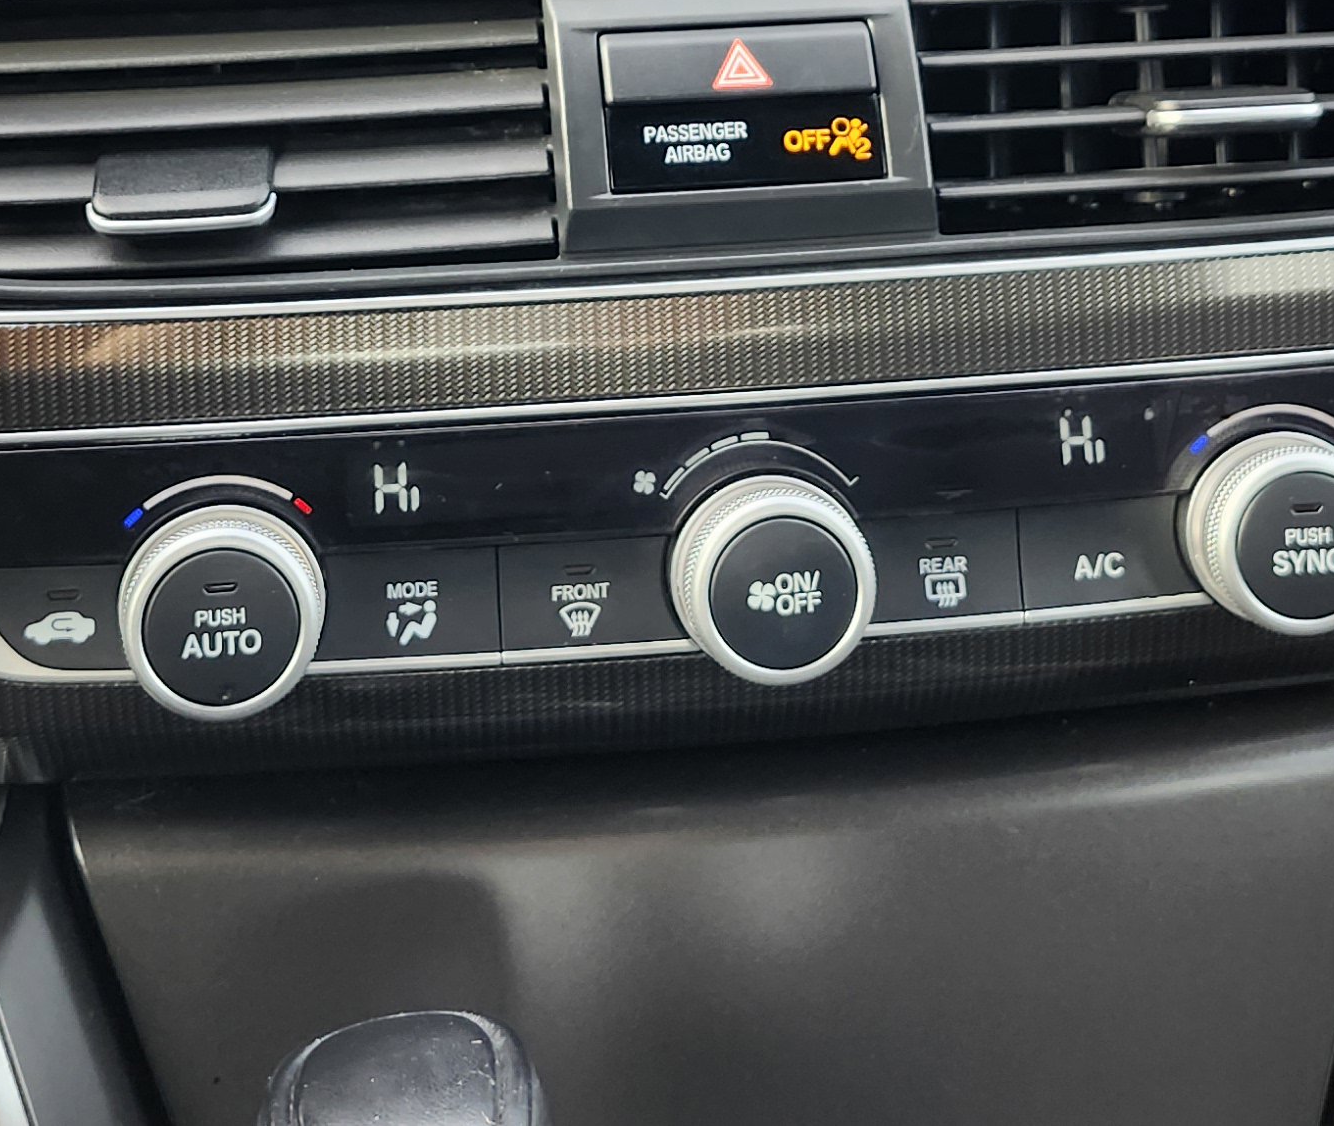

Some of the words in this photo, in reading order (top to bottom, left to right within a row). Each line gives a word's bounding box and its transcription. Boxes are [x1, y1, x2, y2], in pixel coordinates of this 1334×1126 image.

[643, 121, 748, 144] PASSENGER
[783, 128, 831, 154] OFF
[664, 143, 731, 164] AIRBAG
[1284, 526, 1332, 546] PUSH
[919, 555, 968, 574] REAR
[1074, 552, 1125, 579] A/C
[385, 581, 438, 600] MODE
[551, 581, 610, 602] FRONT
[775, 571, 821, 593] ON/
[776, 593, 822, 616] OFF
[194, 607, 246, 629] PUSH
[181, 629, 262, 660] AUTO
